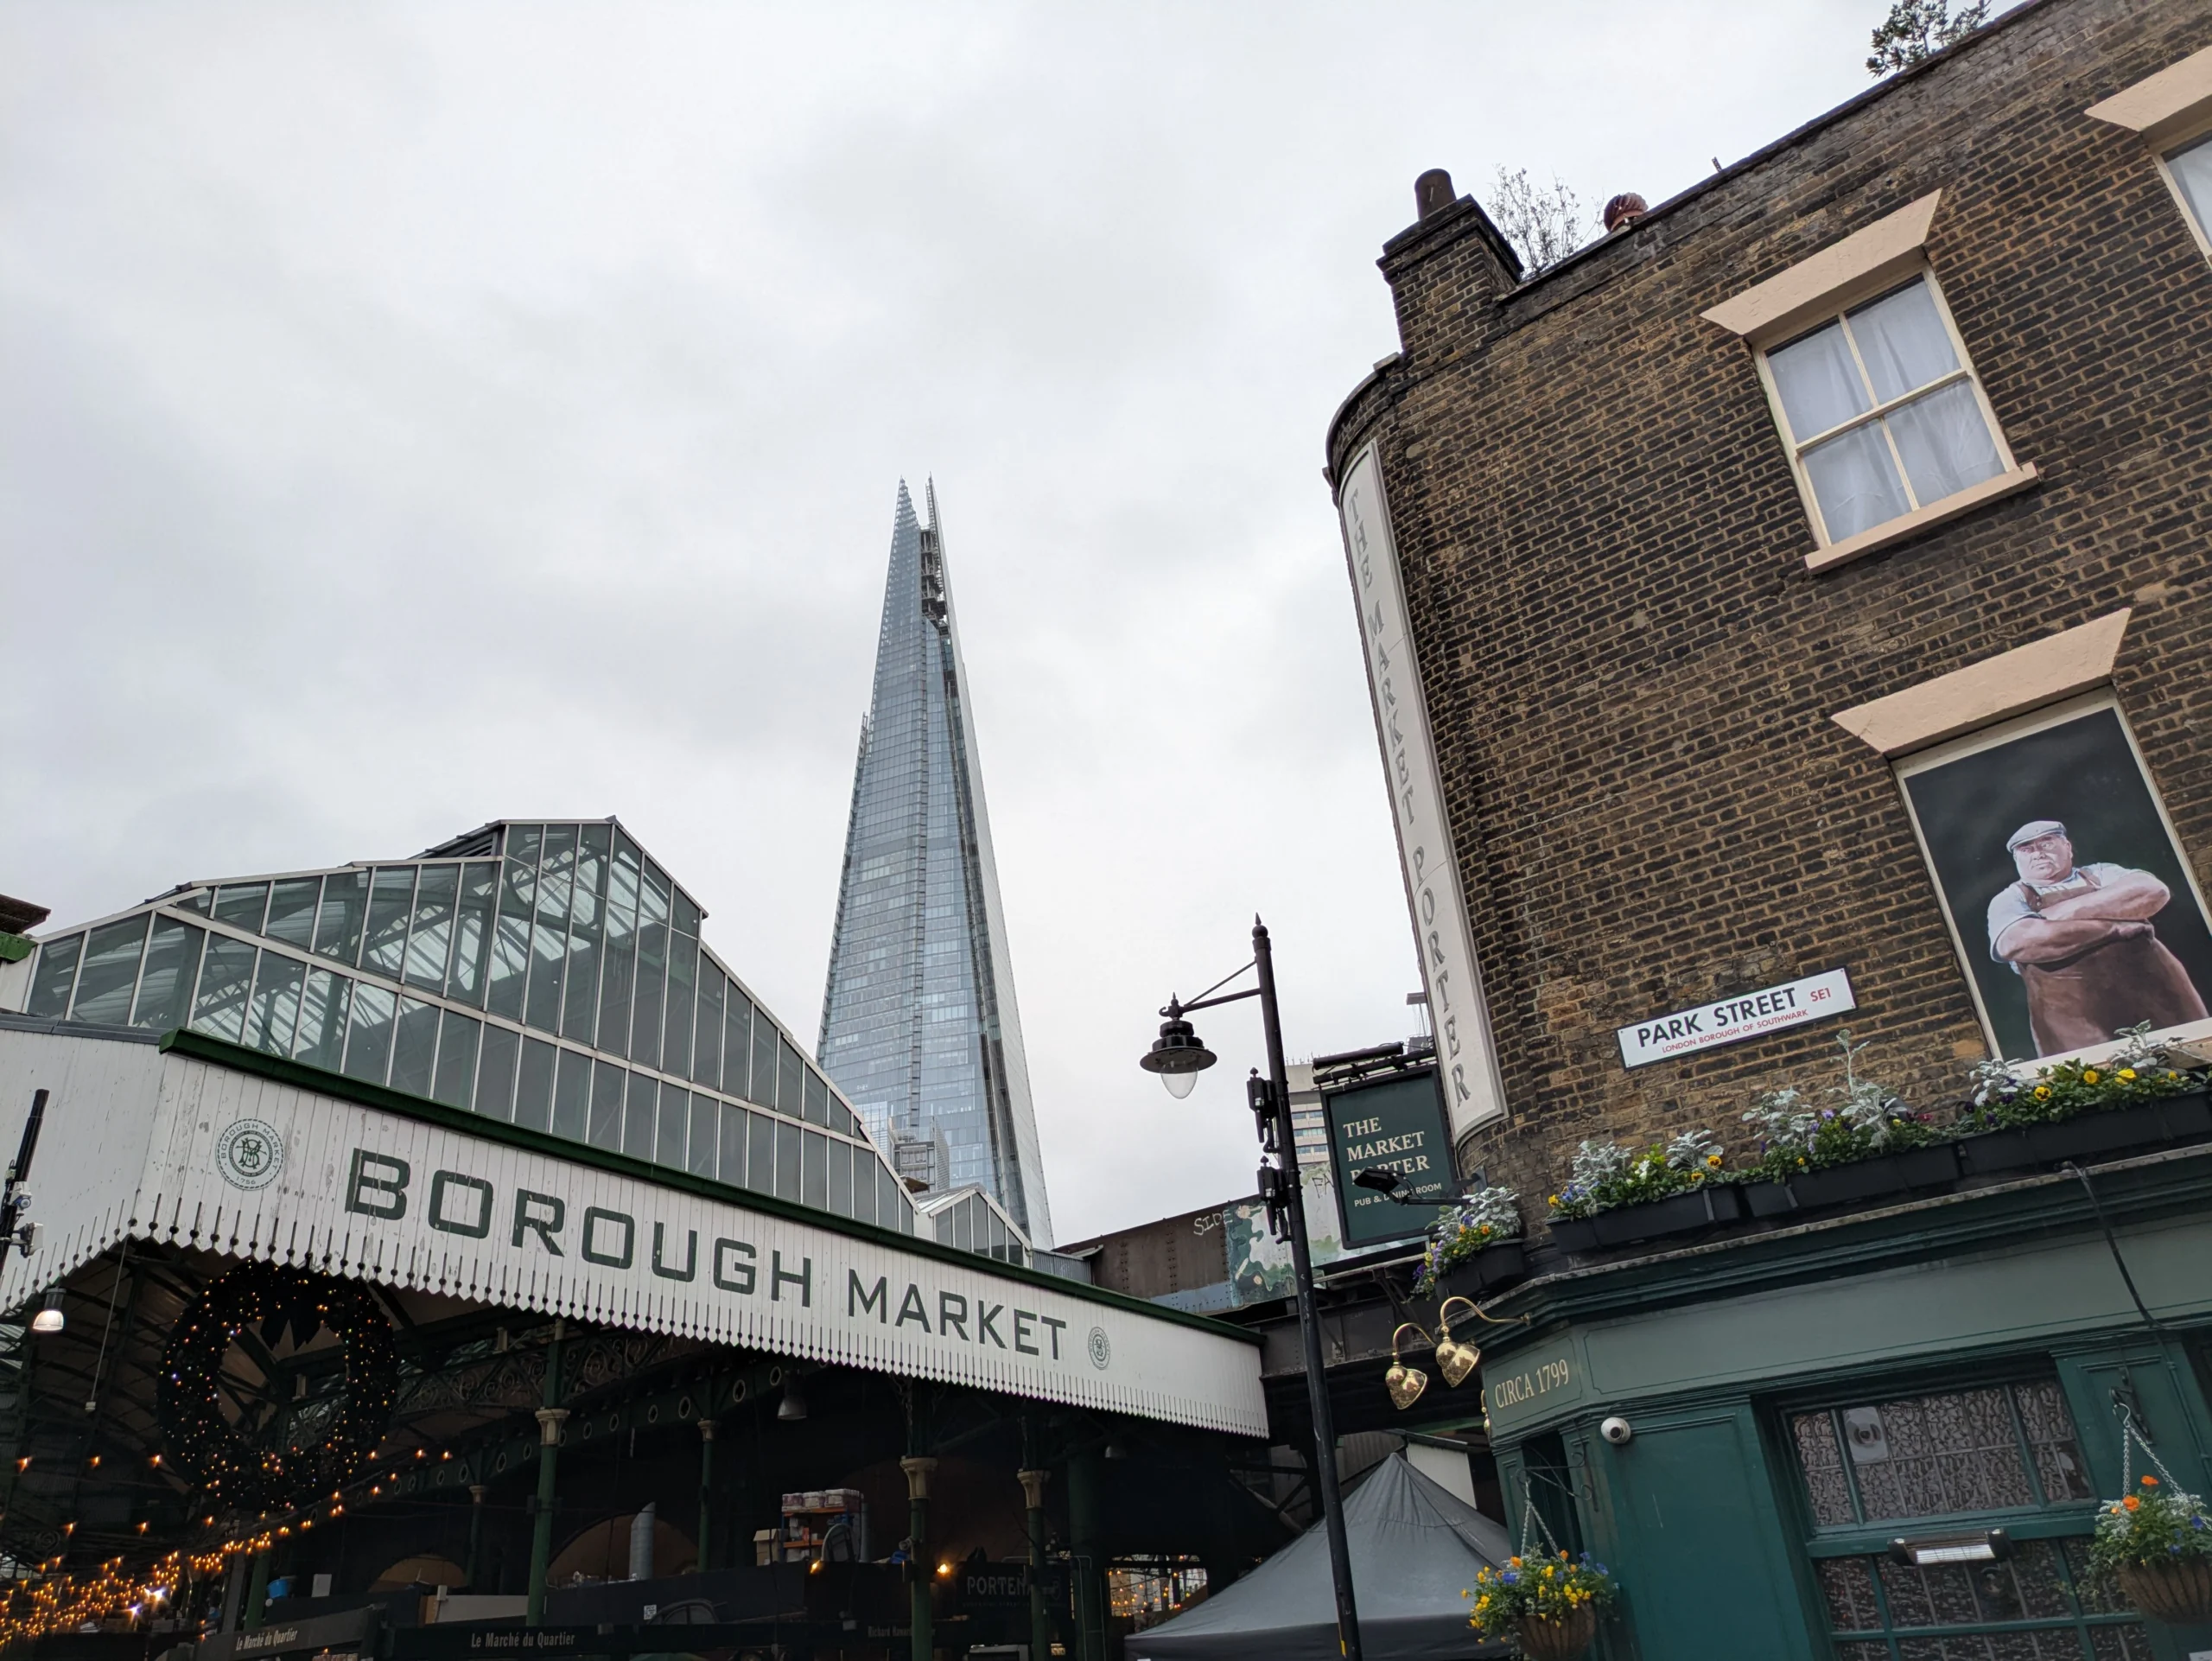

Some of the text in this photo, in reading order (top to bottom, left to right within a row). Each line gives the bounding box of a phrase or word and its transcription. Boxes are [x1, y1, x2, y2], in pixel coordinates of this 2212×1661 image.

[1349, 487, 1471, 1108] THE MARKET PORTER
[1637, 987, 1832, 1047] PARK STREET SE1
[1662, 1009, 1808, 1053] LONDON BOROUGH OF SOUTHWARK
[1343, 1117, 1382, 1138] THE
[220, 1123, 259, 1159] BOROUGH
[262, 1128, 280, 1171] MARKET
[1346, 1131, 1425, 1162] MARKET
[236, 1175, 257, 1185] 1756
[1350, 1155, 1430, 1185] PTER
[1354, 1197, 1371, 1207] PUB
[1415, 1182, 1442, 1194] ROOM
[1193, 1209, 1233, 1237] SIDE
[345, 1148, 1067, 1360] BOROUGH MARKET
[1495, 1359, 1569, 1409] CIRCA 1799
[235, 1627, 298, 1651] Le Marché du Quartier
[471, 1631, 575, 1649] Le Marché du Quartier
